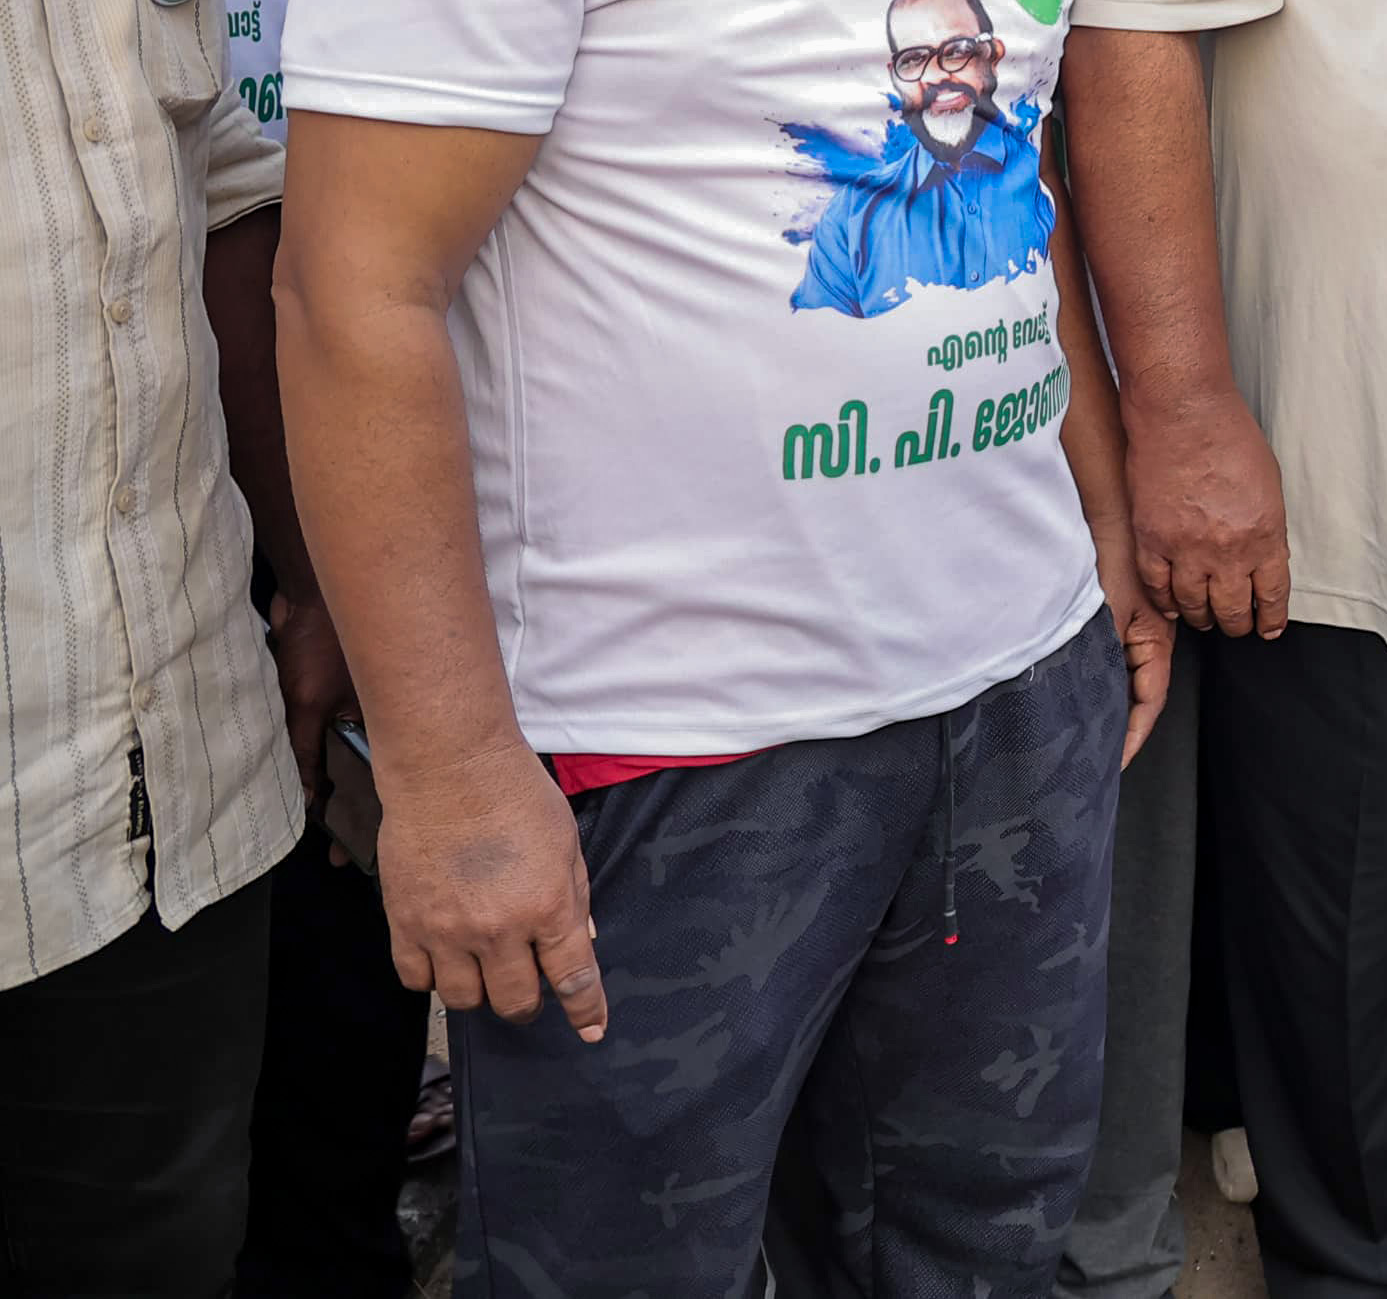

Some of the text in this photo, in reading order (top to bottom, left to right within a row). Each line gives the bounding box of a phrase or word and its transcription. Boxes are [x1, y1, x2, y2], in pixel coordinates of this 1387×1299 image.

[927, 318, 1008, 371] എന്റെ
[782, 399, 881, 480] സി.
[894, 388, 961, 468] പി.
